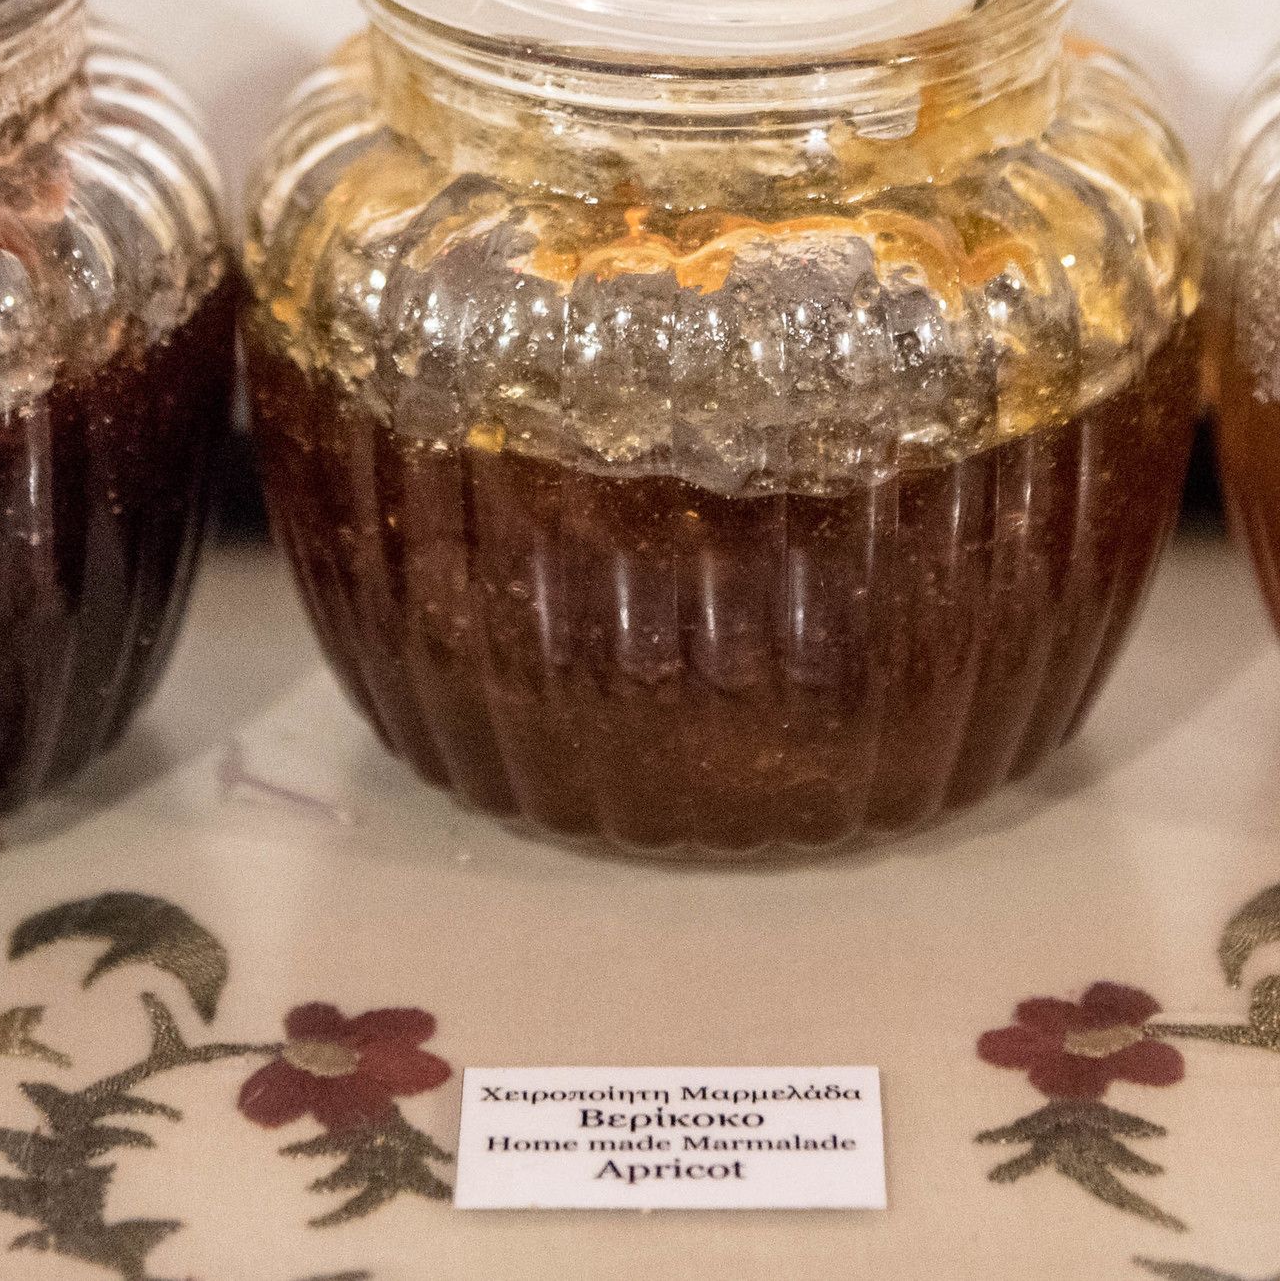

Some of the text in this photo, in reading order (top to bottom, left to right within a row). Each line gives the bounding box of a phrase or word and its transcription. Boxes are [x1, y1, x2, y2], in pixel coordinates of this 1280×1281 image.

[481, 1085, 862, 1104] Χειροποίητη Μαρμελάδα
[578, 1106, 765, 1130] Βερίκοκο
[486, 1135, 857, 1152] Home made Marmalade
[593, 1158, 747, 1184] Apricot
